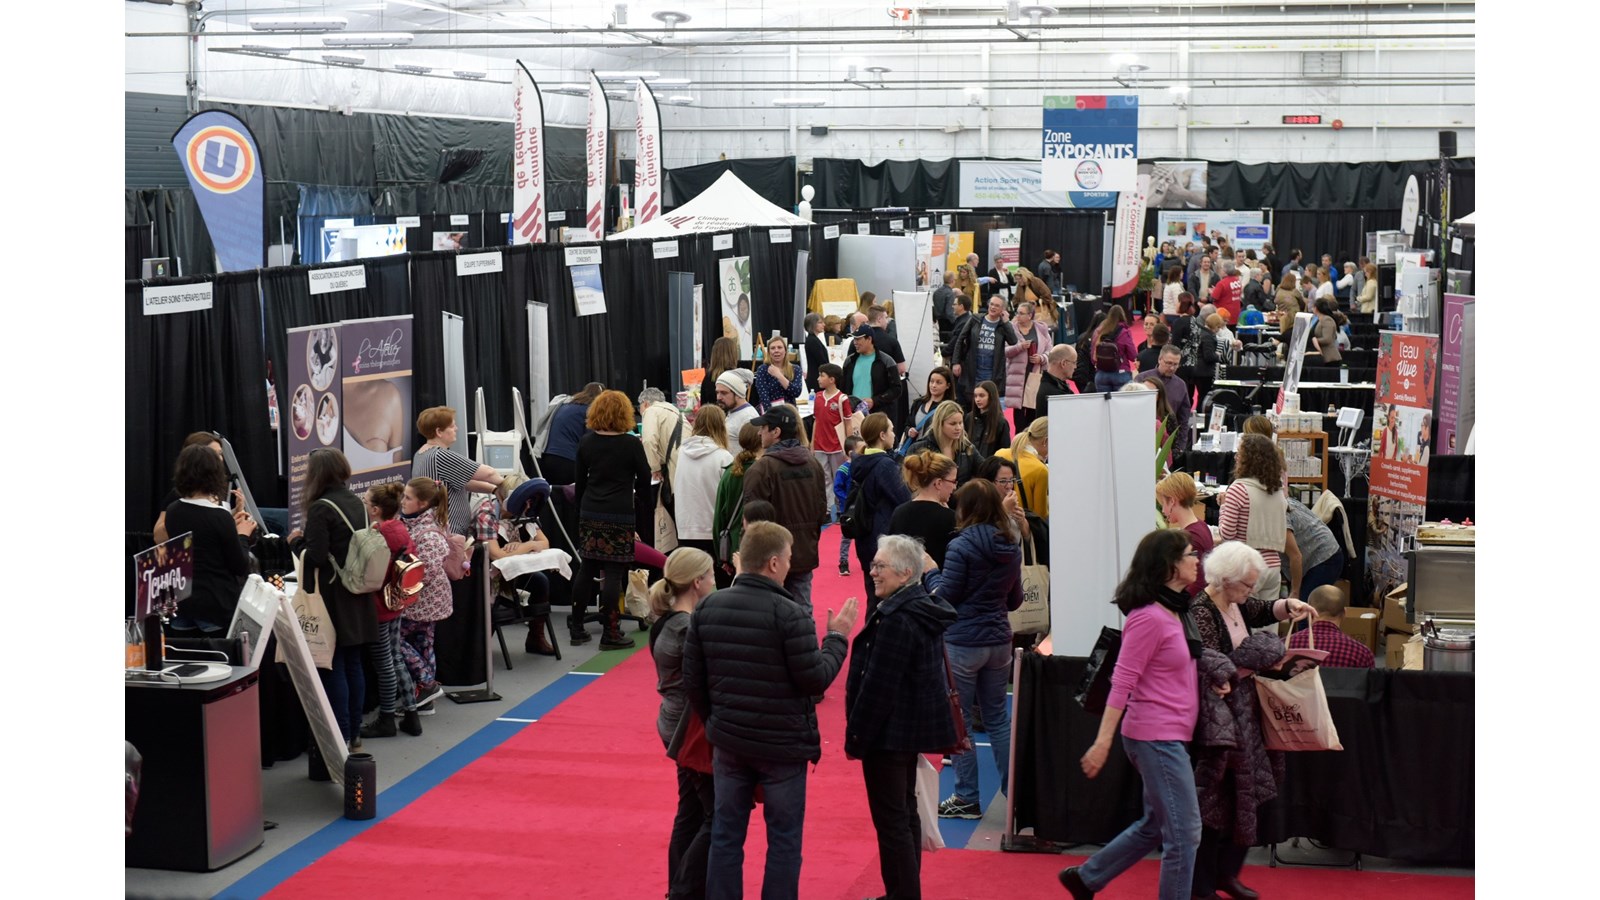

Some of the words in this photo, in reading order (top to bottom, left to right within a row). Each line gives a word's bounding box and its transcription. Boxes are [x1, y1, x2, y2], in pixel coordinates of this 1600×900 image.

[1044, 129, 1072, 143] Zone
[1044, 143, 1134, 159] EXPOSANTS
[1000, 177, 1020, 185] Sport
[145, 296, 168, 306] L'ATELIER
[168, 294, 181, 304] SOINS
[1396, 359, 1418, 377] Vive
[349, 481, 364, 491] Après
[371, 478, 386, 486] cancer
[386, 475, 393, 483] du
[1273, 710, 1304, 723] DIEM
